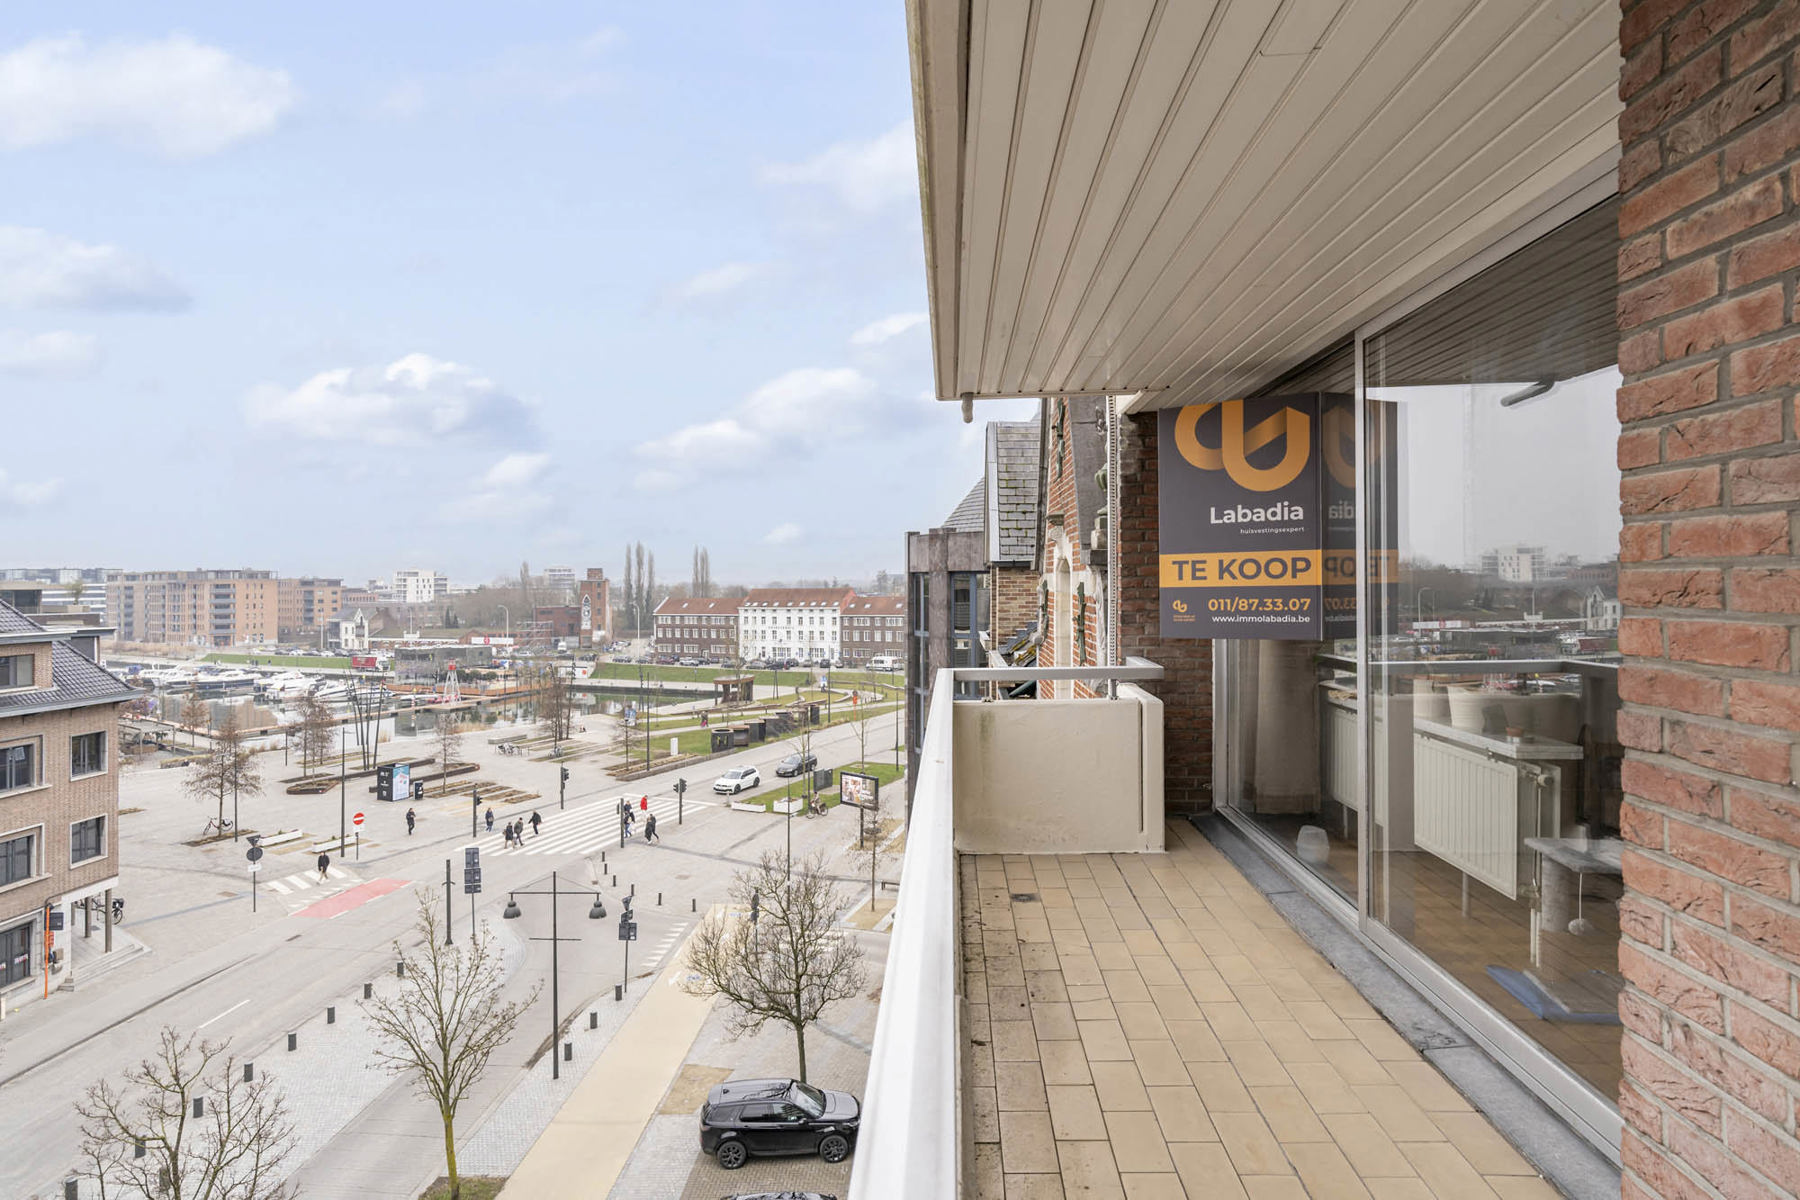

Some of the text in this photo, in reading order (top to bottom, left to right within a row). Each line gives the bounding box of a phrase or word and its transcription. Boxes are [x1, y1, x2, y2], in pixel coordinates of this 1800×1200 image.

[1210, 501, 1304, 524] Labadia
[1172, 557, 1311, 581] TE KOOP
[1208, 598, 1311, 613] 011/87.33.07
[1212, 614, 1310, 623] www.immolabadia.be
